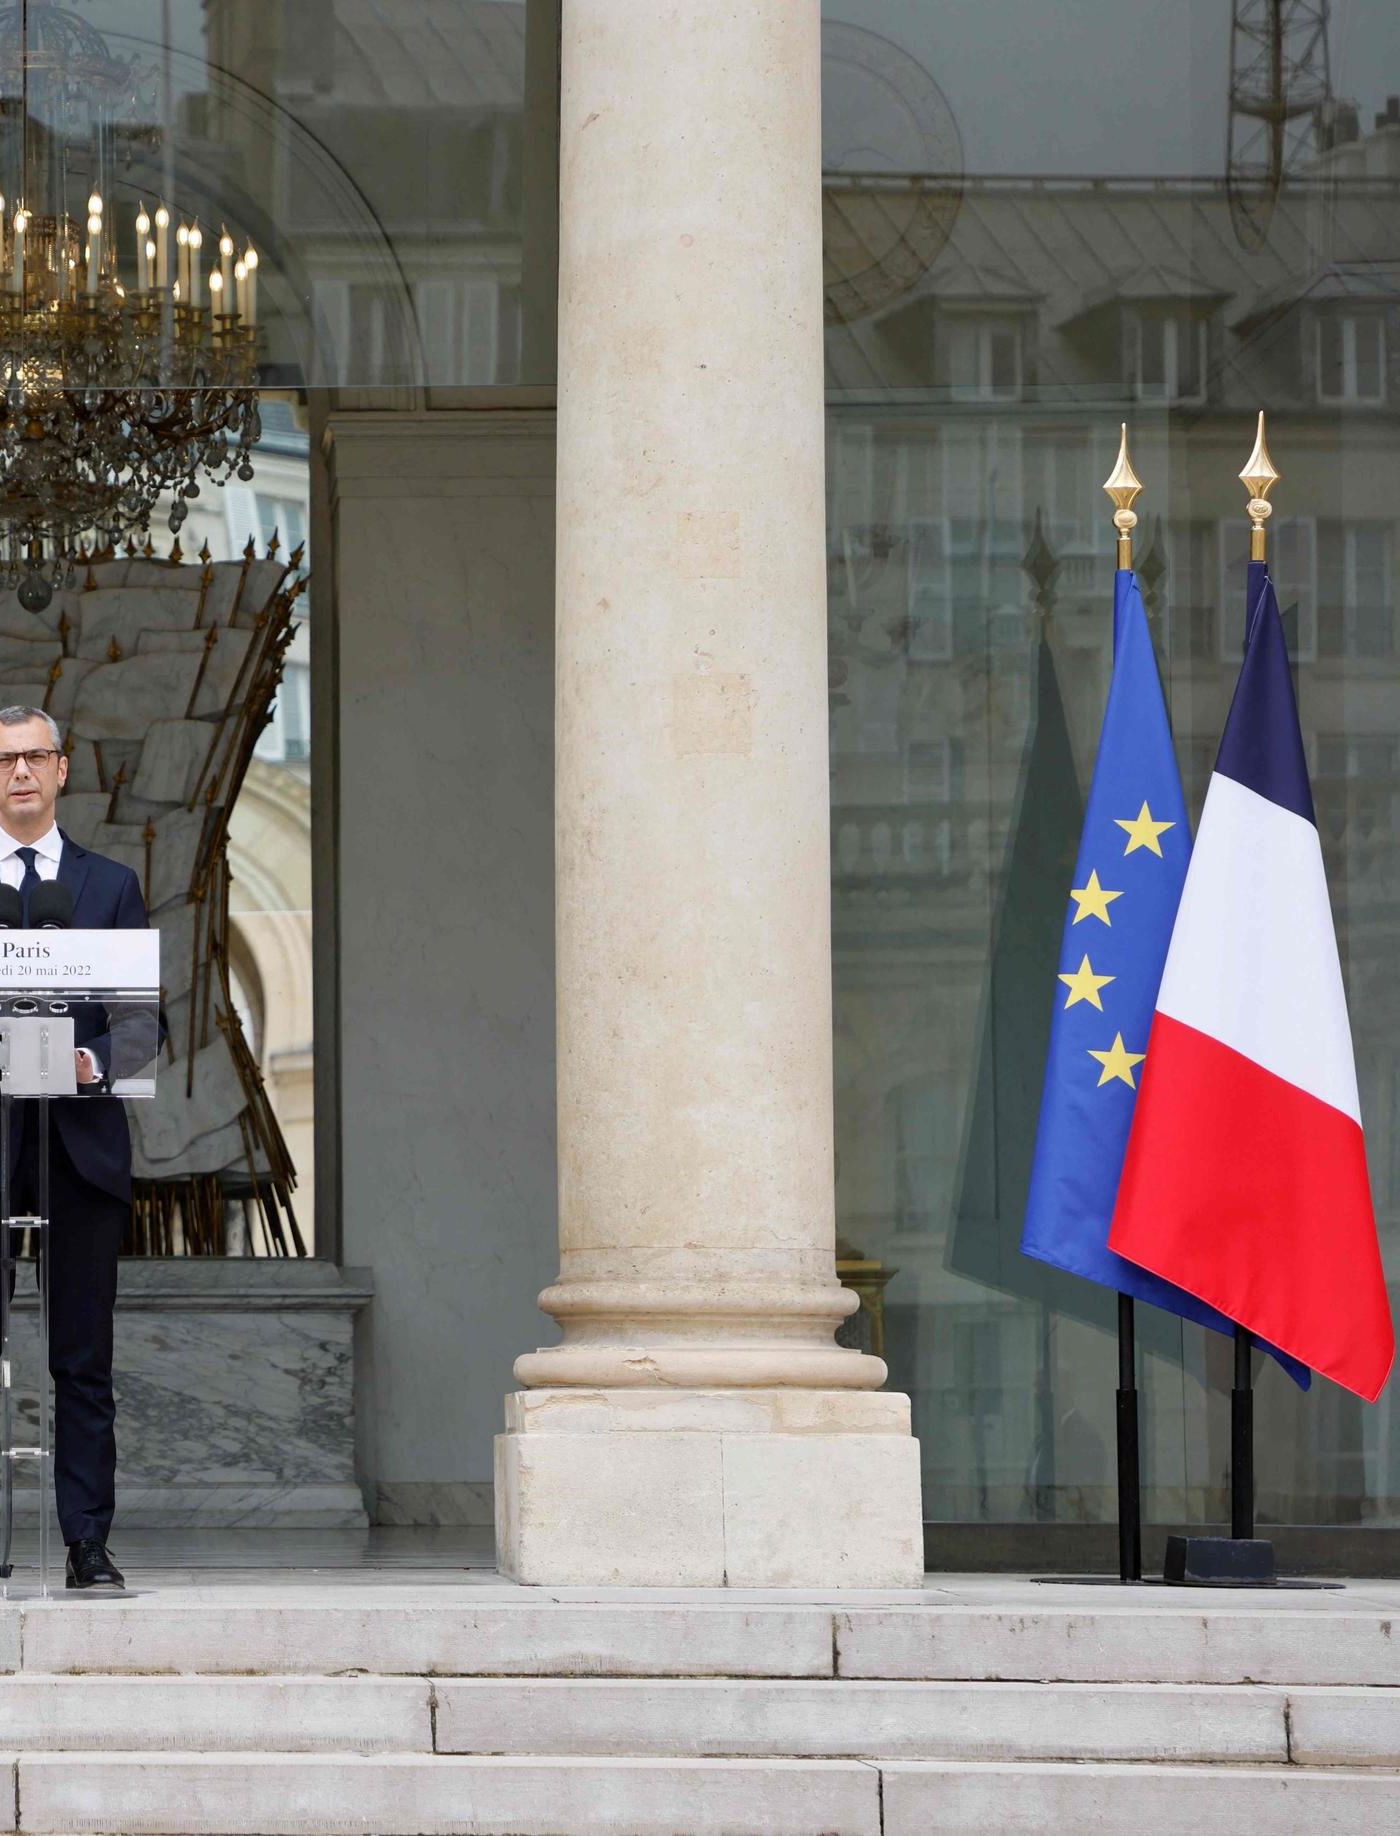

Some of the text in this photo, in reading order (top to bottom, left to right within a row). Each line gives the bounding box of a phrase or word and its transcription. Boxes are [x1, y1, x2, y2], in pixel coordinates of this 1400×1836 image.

[2, 941, 51, 959] Paris
[17, 964, 32, 976] 20
[36, 964, 58, 976] mai
[62, 964, 92, 976] 2022
